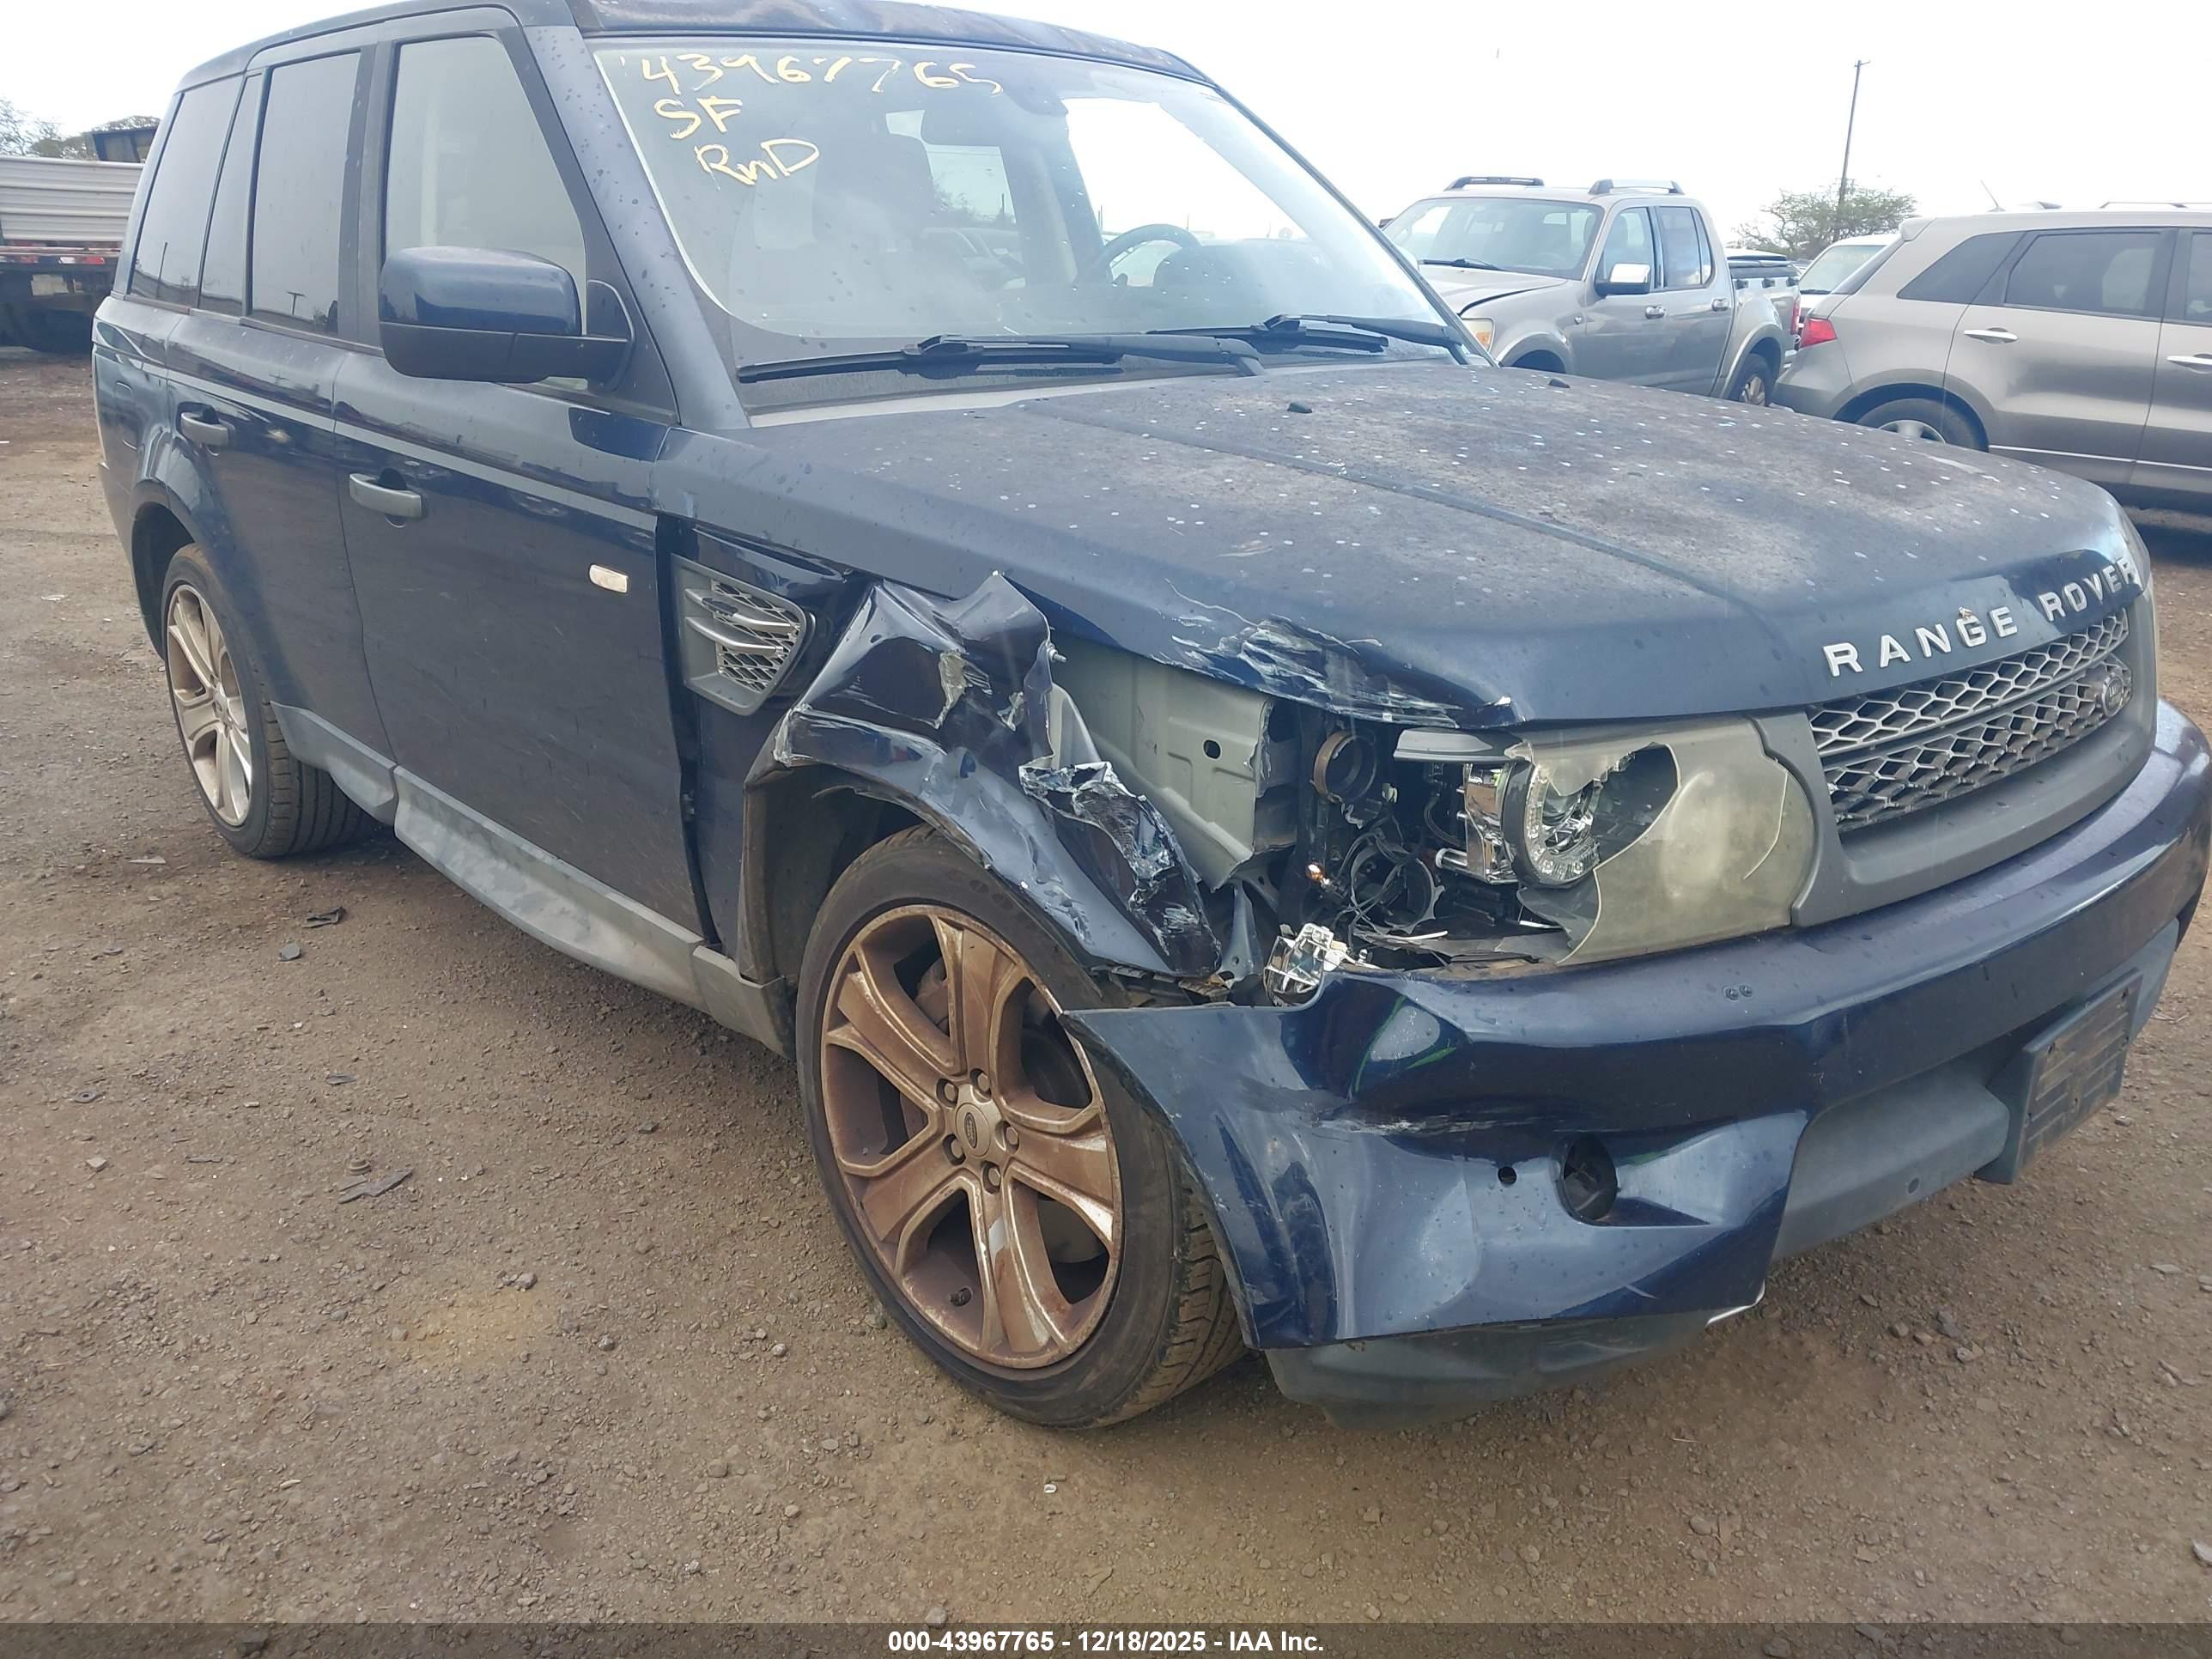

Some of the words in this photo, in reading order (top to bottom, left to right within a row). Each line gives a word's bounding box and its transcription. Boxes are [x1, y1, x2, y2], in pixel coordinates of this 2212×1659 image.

[641, 53, 1004, 96] 43967765
[653, 95, 744, 139] SF
[1821, 605, 2018, 678] RANGE
[2037, 556, 2144, 622] ROVER
